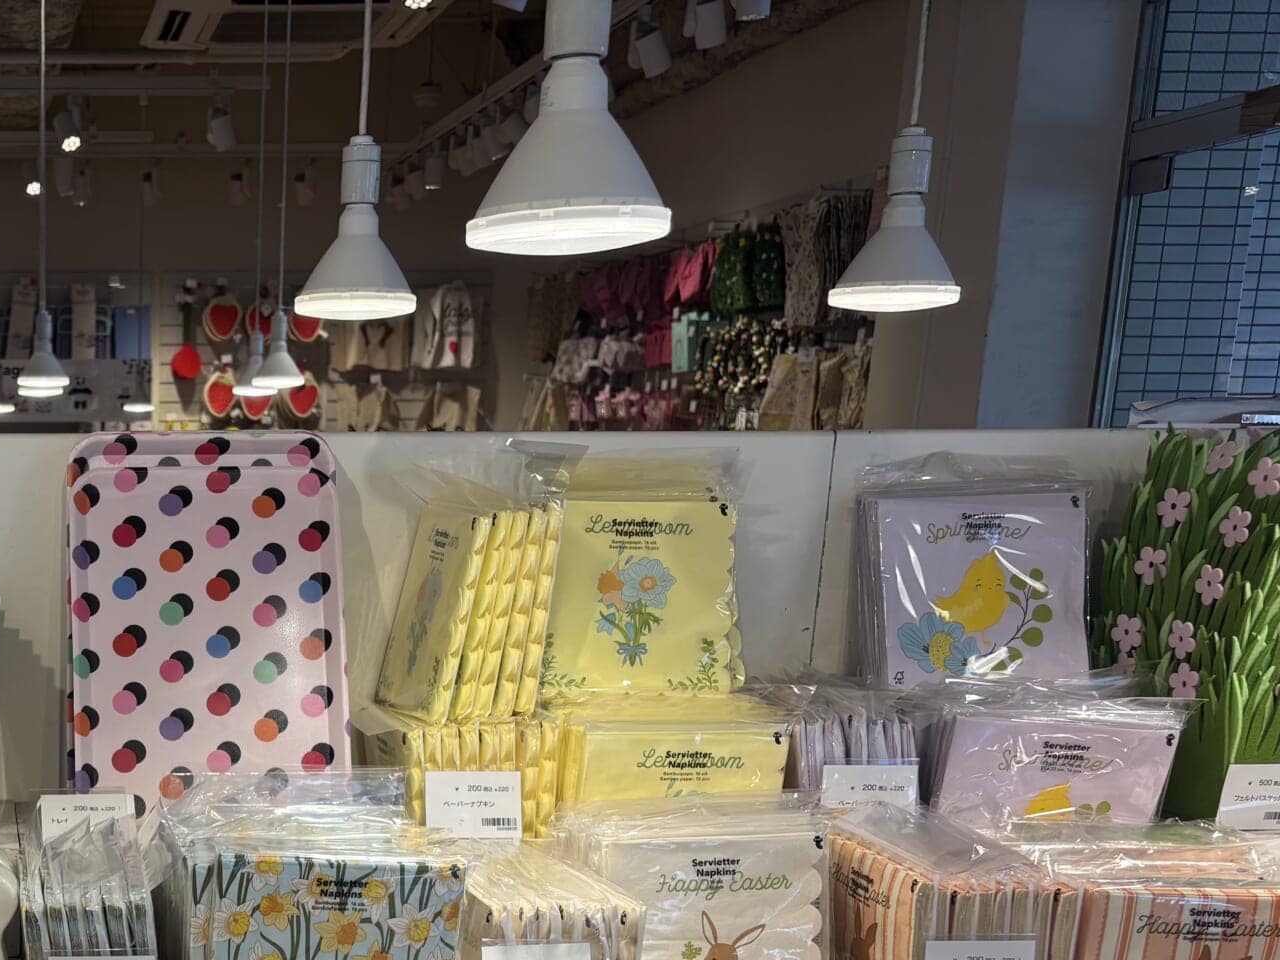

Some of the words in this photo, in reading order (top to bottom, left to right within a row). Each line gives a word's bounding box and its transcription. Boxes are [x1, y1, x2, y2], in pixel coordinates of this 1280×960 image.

[615, 529, 654, 539] Napkins
[1043, 741, 1091, 752] Servietter
[665, 750, 712, 759] Servietter
[668, 760, 707, 770] Napkins
[691, 858, 741, 867] Servietter
[696, 868, 737, 878] Napkins
[316, 878, 368, 888] Servietter
[656, 873, 720, 900] Happy
[729, 871, 792, 892] Easter
[320, 889, 363, 899] Napkins
[1189, 908, 1242, 919] Servietter
[1192, 919, 1234, 930] Napkins
